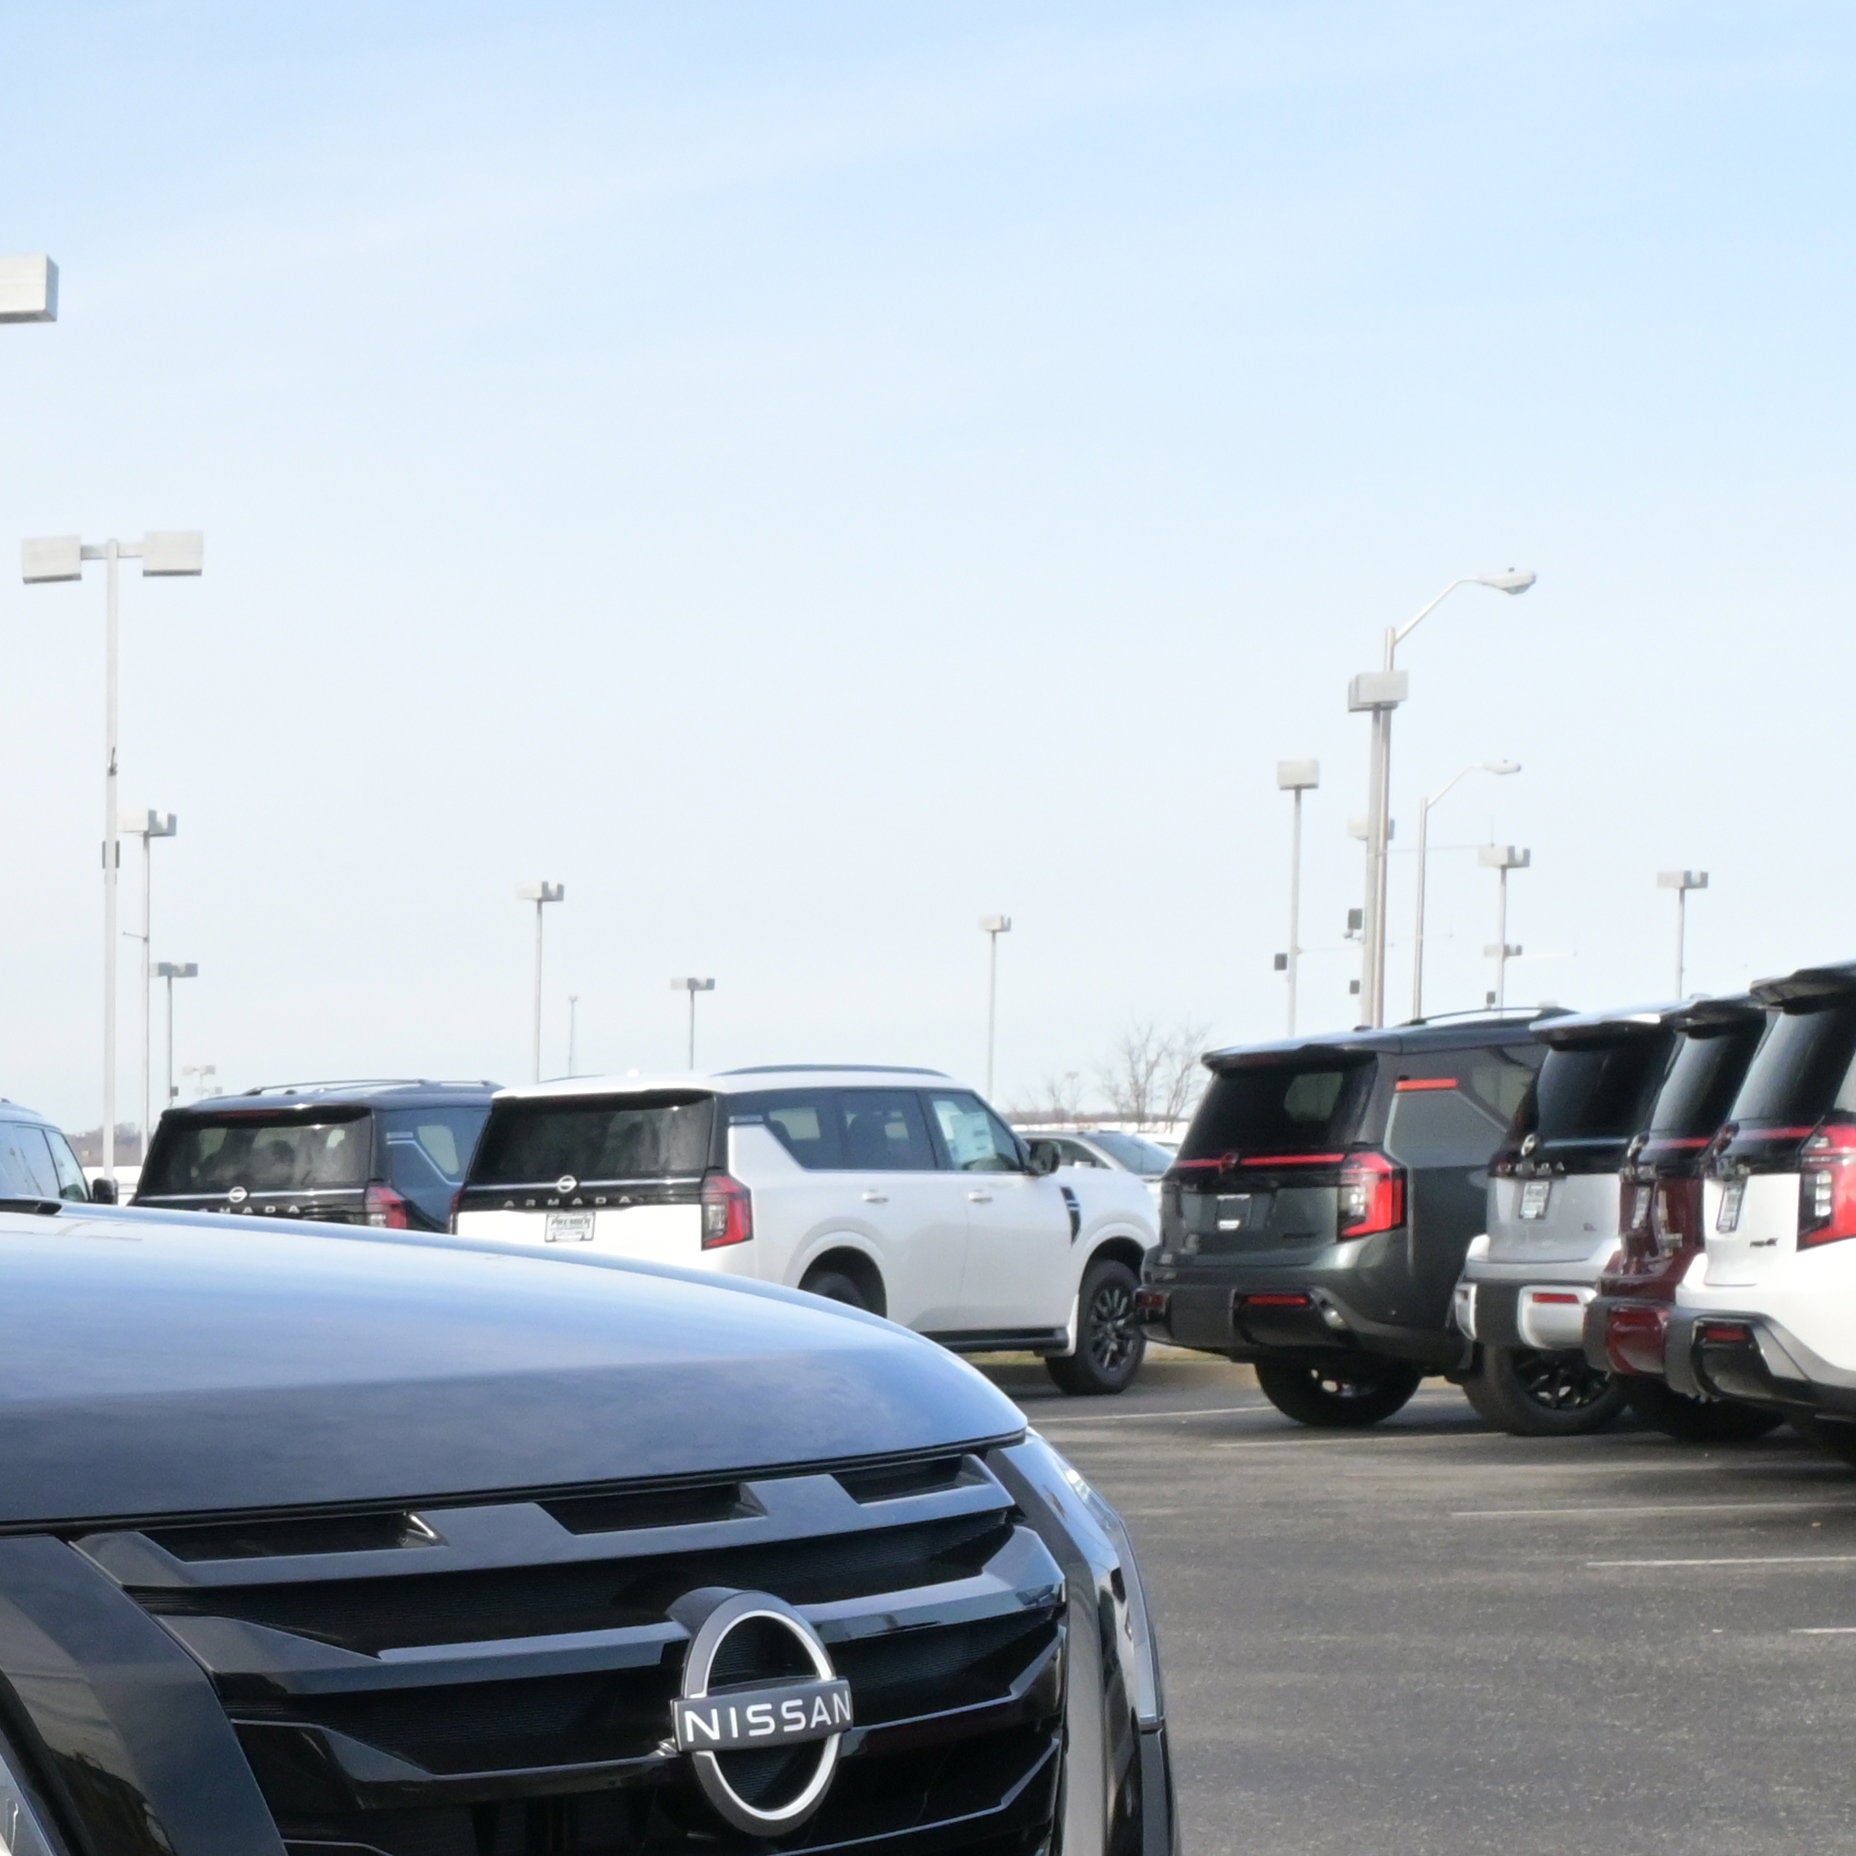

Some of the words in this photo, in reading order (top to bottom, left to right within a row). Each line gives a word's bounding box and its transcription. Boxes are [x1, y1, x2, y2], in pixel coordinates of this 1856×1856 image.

[503, 1195, 631, 1207] ARMADA
[198, 1205, 300, 1214] RMADA
[684, 1690, 852, 1742] NISSAN
